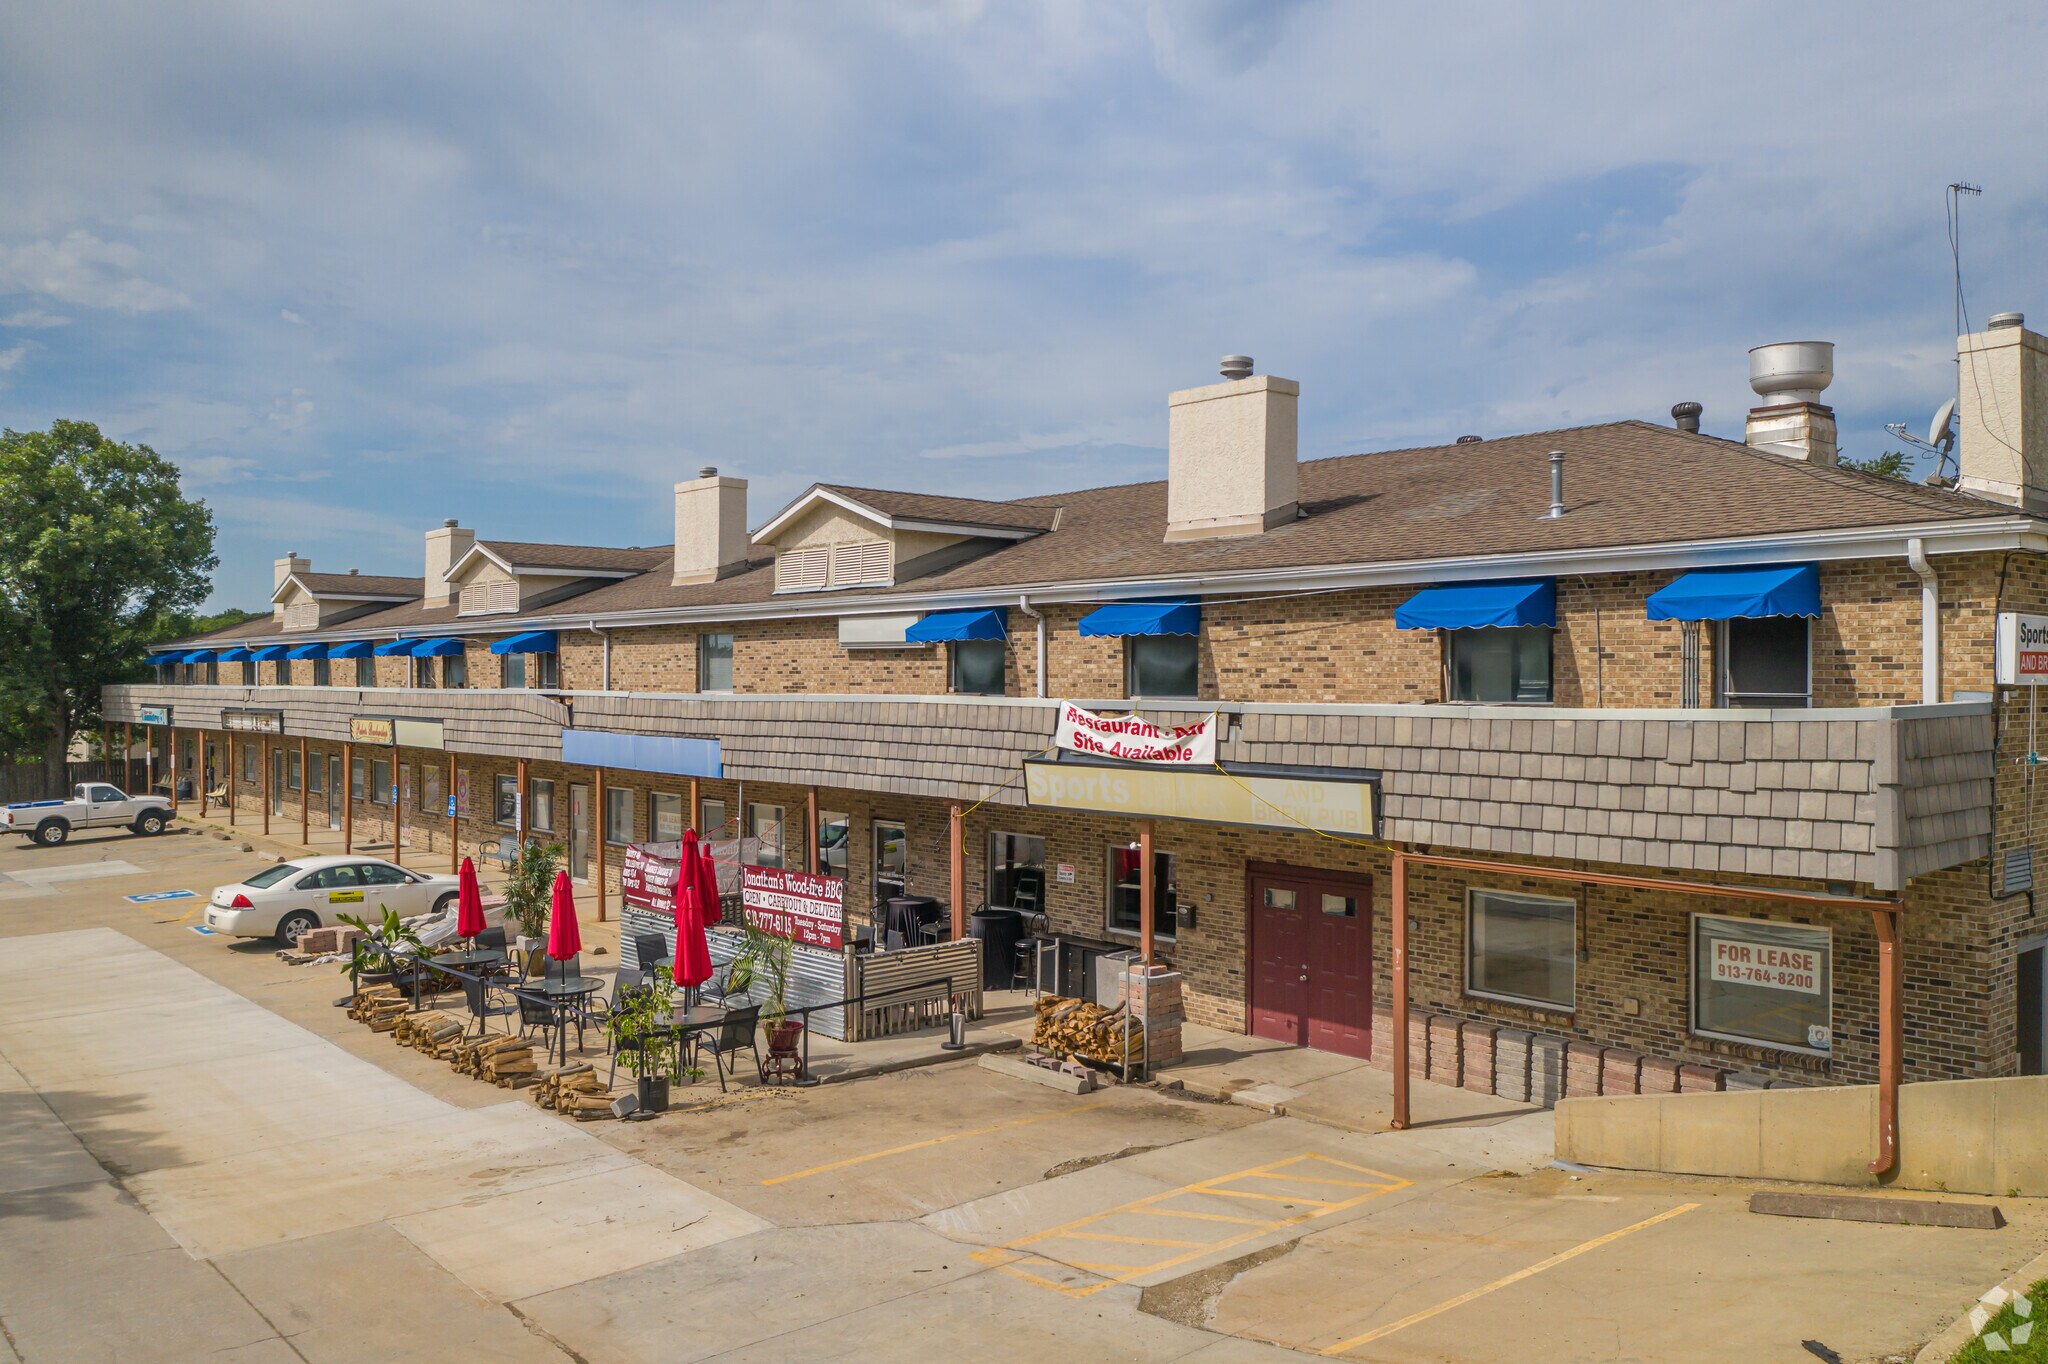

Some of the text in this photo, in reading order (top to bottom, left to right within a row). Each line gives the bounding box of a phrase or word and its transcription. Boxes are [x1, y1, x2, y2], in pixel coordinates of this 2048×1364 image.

[2020, 655, 2037, 671] AND
[1066, 706, 1160, 739] Restaurant
[1073, 731, 1194, 762] Site Available
[1029, 765, 1131, 806] Sports
[1284, 783, 1325, 803] AND
[1254, 804, 1359, 829] BREW PUB
[743, 867, 784, 891] Jonathan's
[785, 873, 824, 897] Wood-fire
[825, 878, 843, 902] BBQ
[744, 890, 761, 905] OPEN
[767, 894, 802, 912] CARRYOUT
[809, 901, 842, 920] DELIVERY
[794, 915, 815, 931] Tuesday
[817, 920, 842, 936] Saturday
[803, 928, 817, 941] 12pm
[820, 932, 831, 944] 7pm
[1717, 943, 1813, 972] FOR LEASE
[1718, 964, 1813, 989] 913-764-8200
